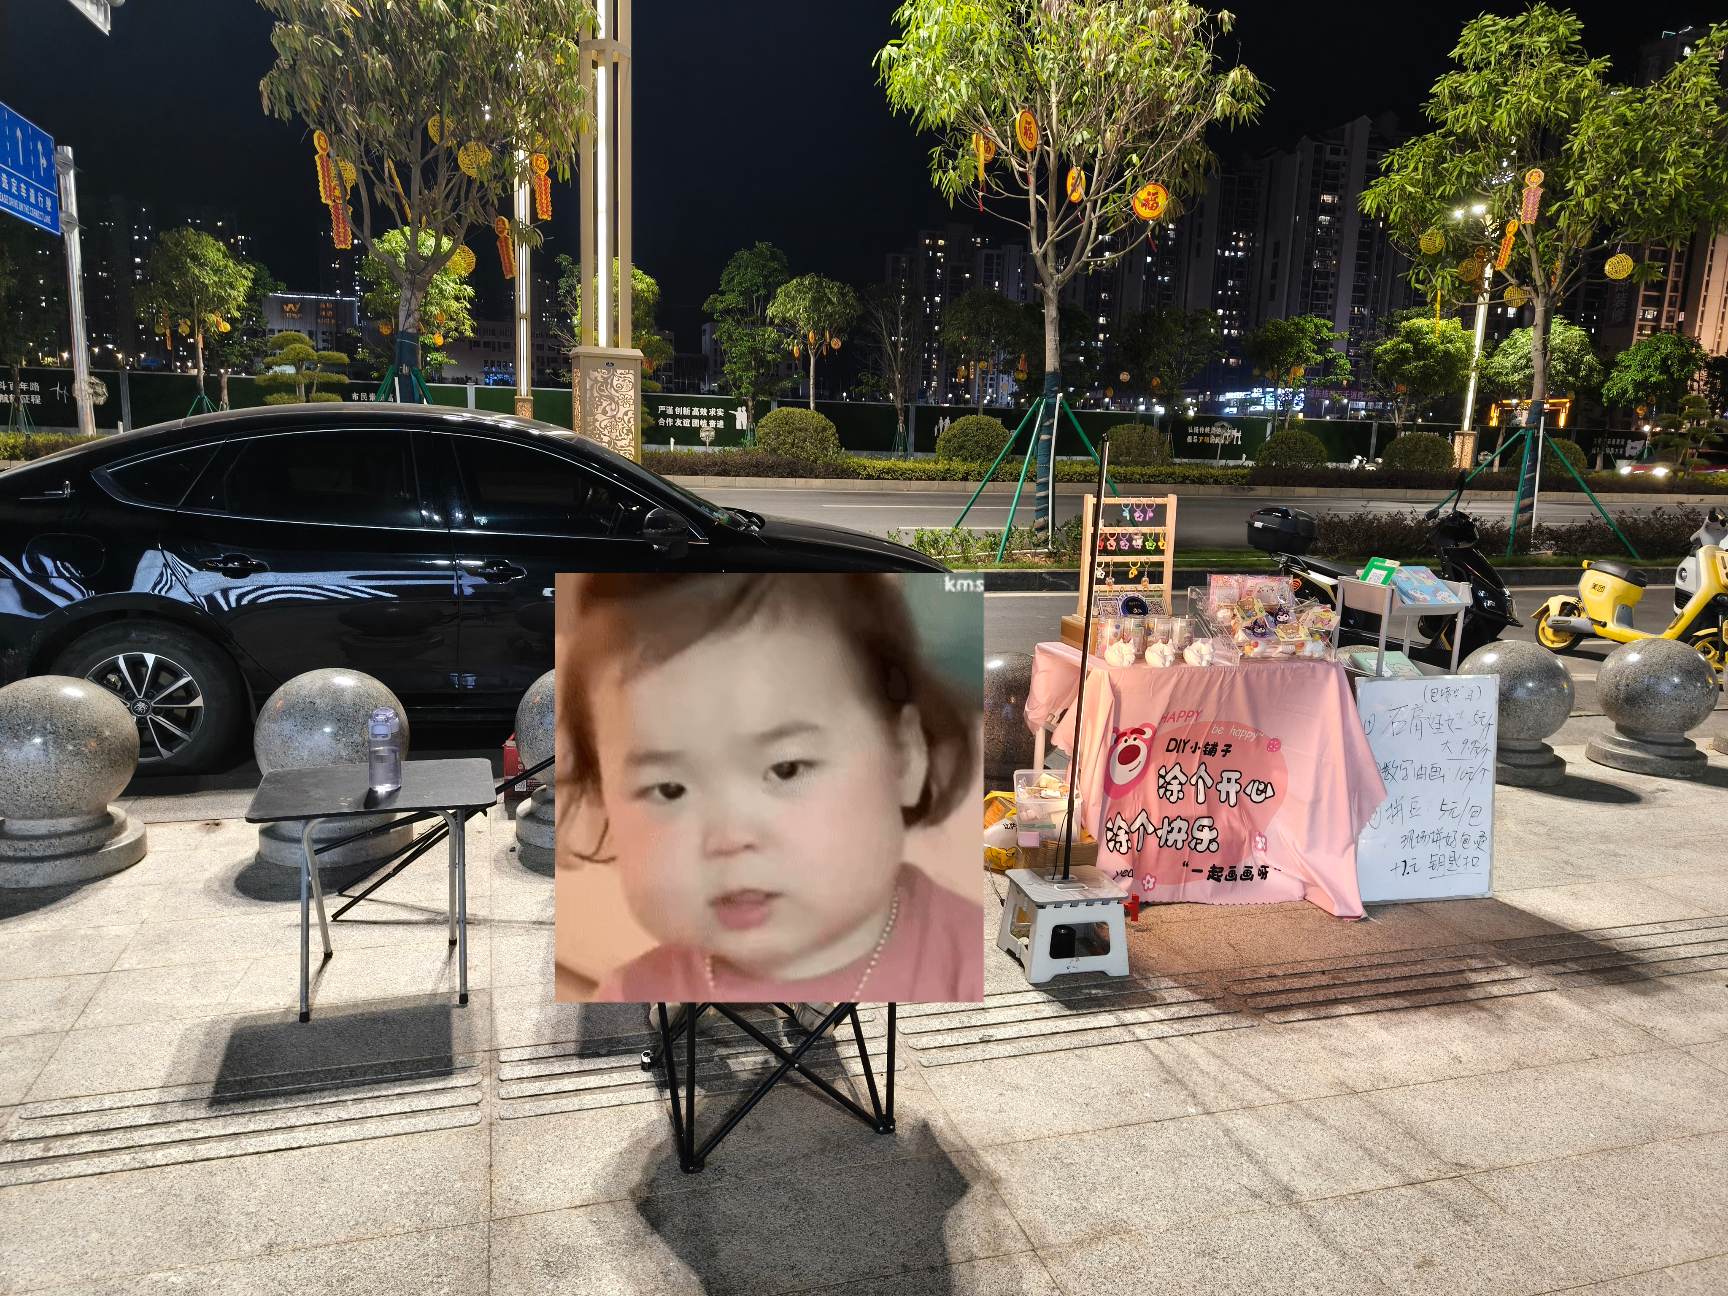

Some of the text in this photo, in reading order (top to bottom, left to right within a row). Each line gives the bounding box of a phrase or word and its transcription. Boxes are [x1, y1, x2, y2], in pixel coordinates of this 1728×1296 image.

[1160, 709, 1203, 724] HAPPY
[1157, 762, 1275, 807] 涂个开心
[1105, 809, 1220, 854] 涂个快乐
